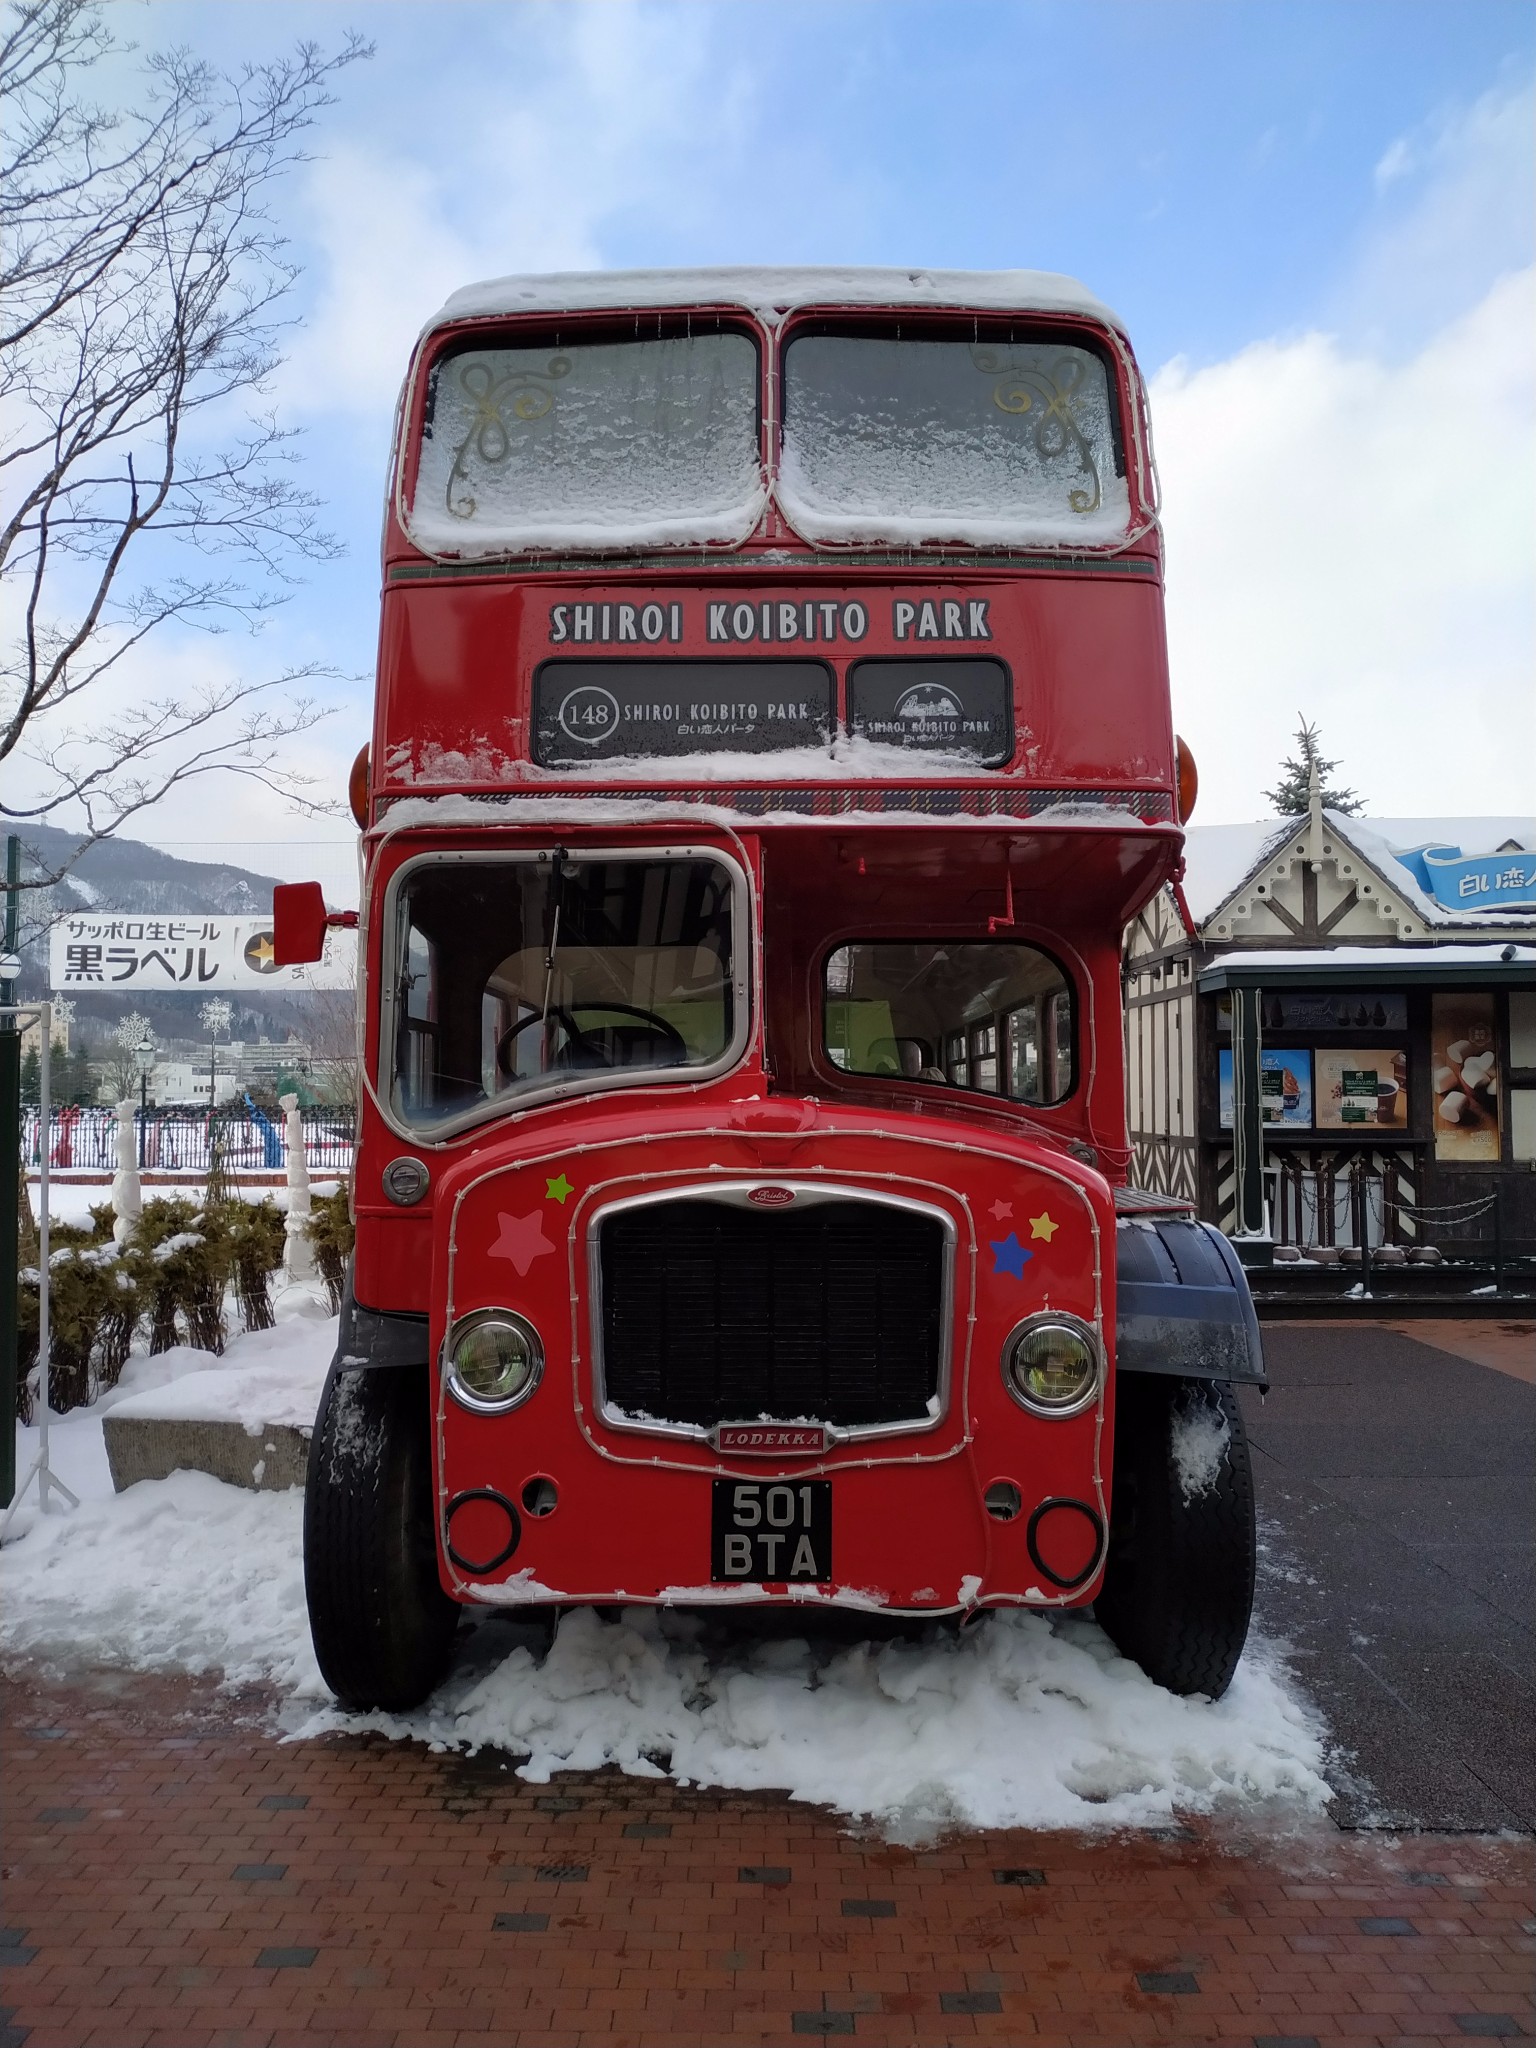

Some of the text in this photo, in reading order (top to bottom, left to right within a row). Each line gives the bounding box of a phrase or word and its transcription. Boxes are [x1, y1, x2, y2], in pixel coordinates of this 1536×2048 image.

[551, 601, 990, 642] SHIROI KOIBITO PARK
[569, 702, 808, 725] 148 SHIROI KOIBITO PARK
[868, 721, 990, 733] SHIROI KOIBITO PARK
[66, 921, 221, 942] サッポロ生ビール
[64, 944, 220, 982] 黒ラベル
[754, 1190, 789, 1203] Bristol
[724, 1433, 819, 1445] LODEKKA
[733, 1485, 812, 1527] 501
[724, 1534, 818, 1576] BTA
